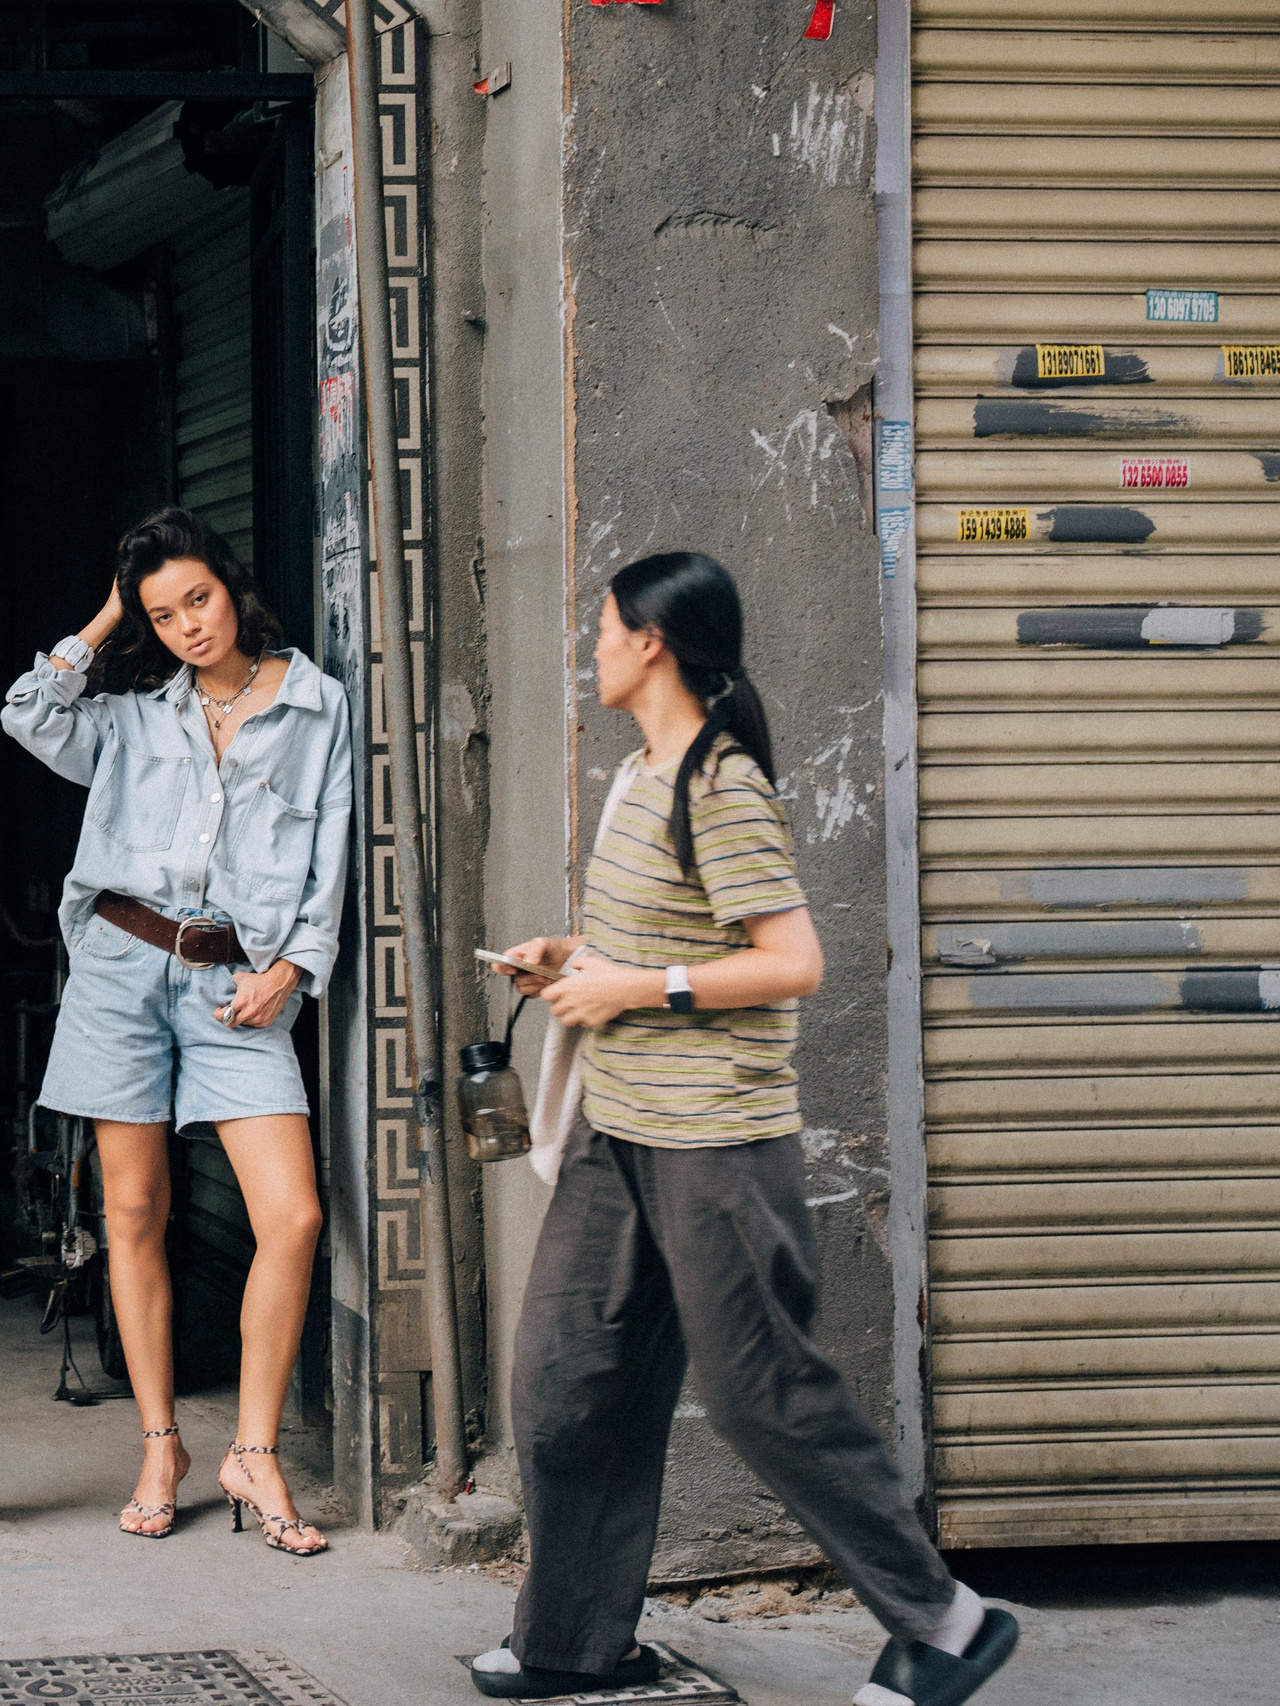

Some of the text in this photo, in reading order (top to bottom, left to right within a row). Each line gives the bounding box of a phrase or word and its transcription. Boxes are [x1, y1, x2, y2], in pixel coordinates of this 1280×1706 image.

[1148, 297, 1215, 322] 130 6097 9705
[1042, 349, 1101, 376] 13189071661
[1122, 465, 1188, 487] 132 6500 0855
[960, 516, 1027, 540] 159 1439 4886
